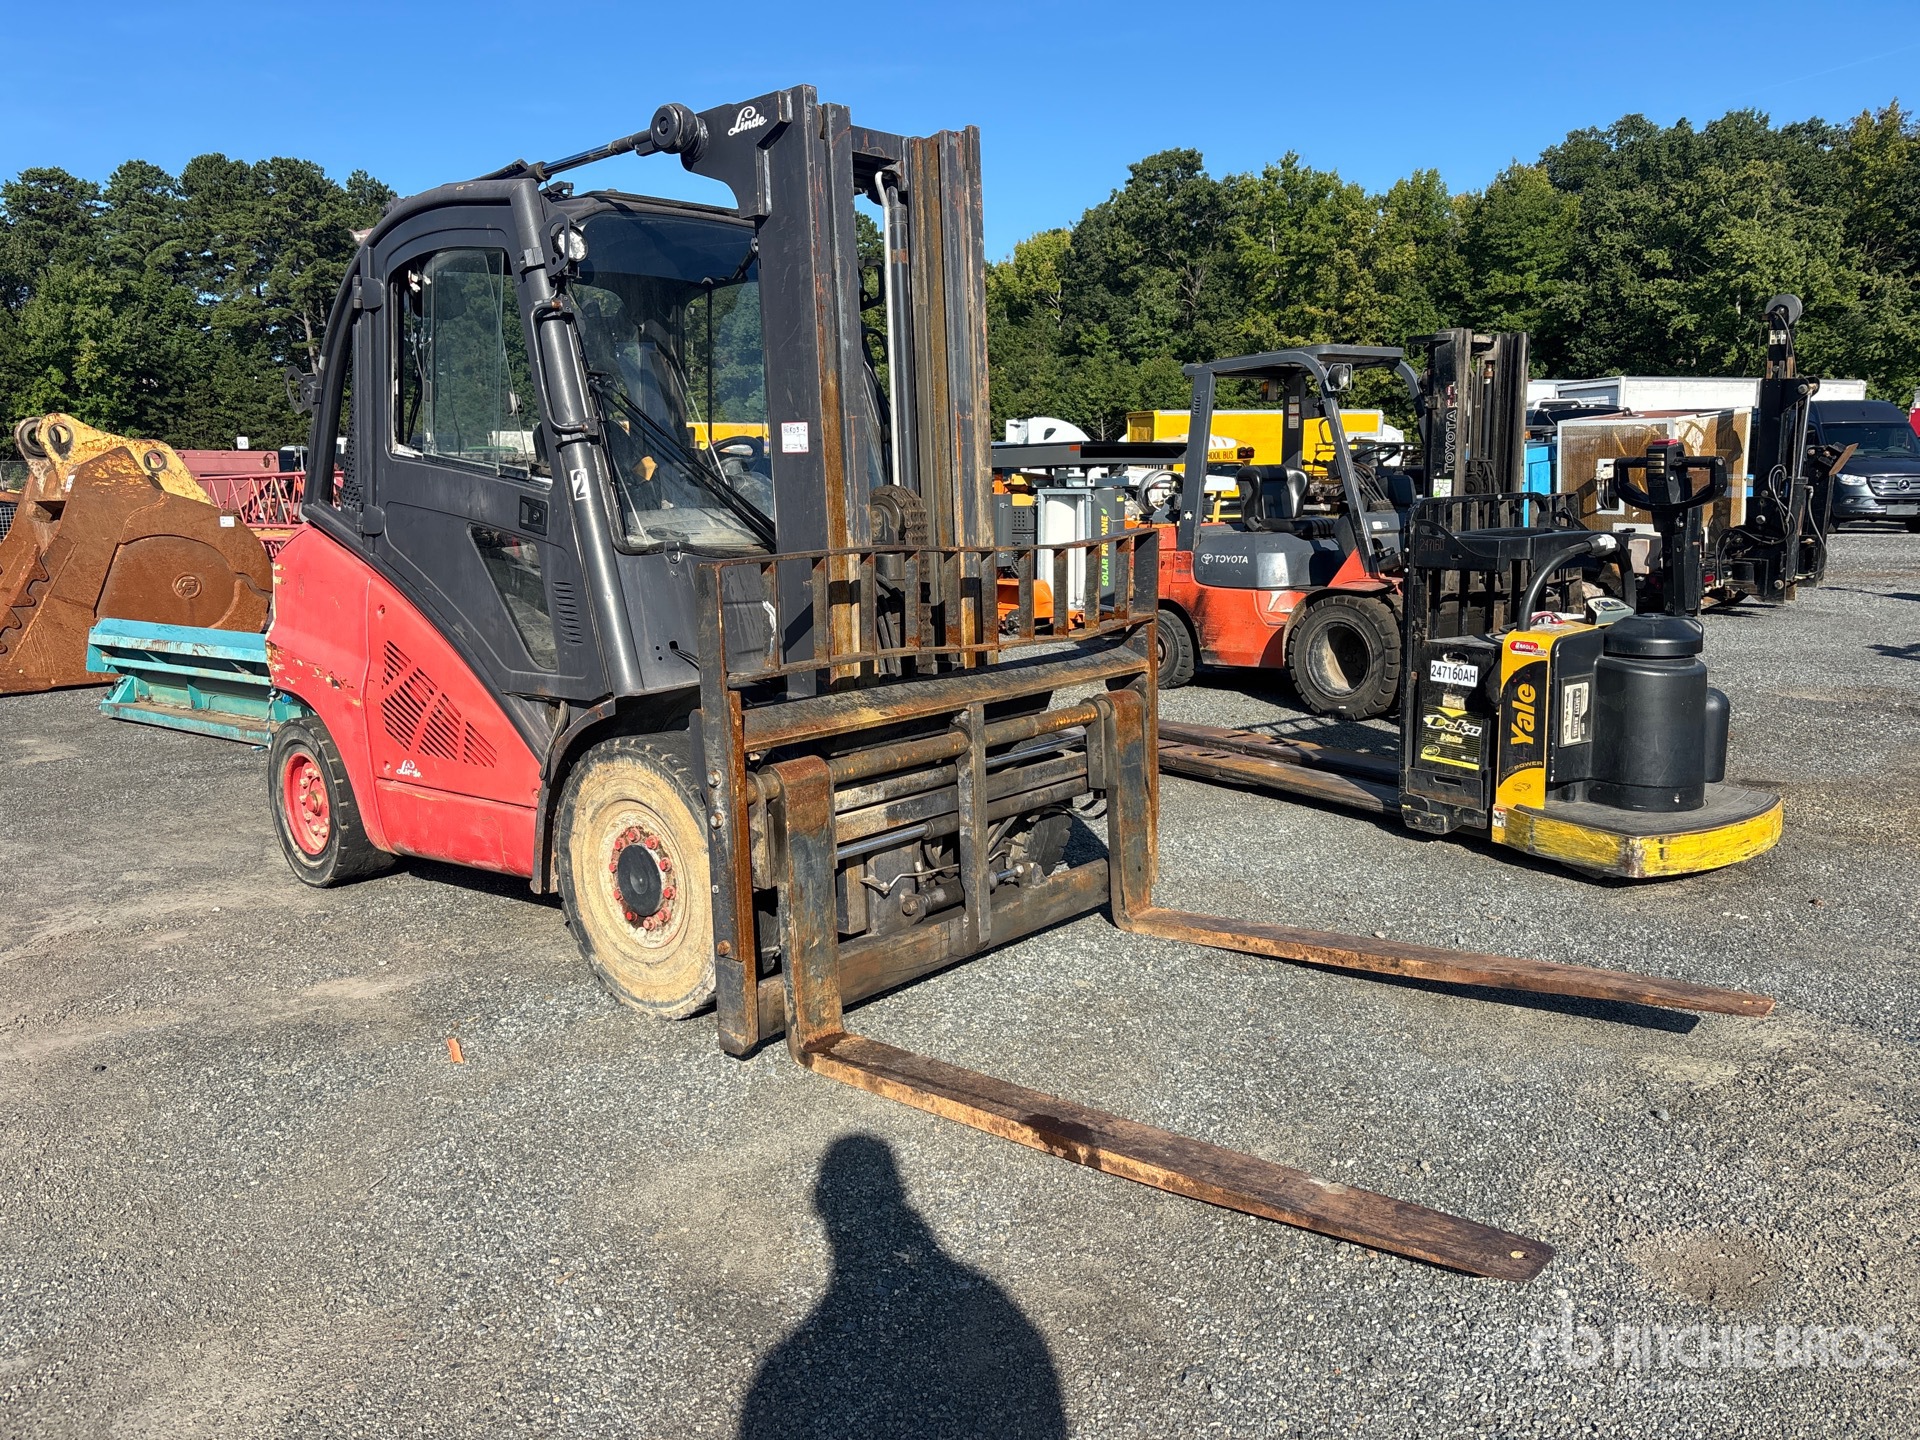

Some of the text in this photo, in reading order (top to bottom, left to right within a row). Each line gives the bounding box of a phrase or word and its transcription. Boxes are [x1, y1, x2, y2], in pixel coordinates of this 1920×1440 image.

[728, 105, 767, 136] Linde
[1444, 409, 1457, 473] TOYOTA
[1207, 451, 1234, 460] HOOL BUS
[573, 470, 587, 499] 2
[1101, 515, 1109, 587] SOLAR PRANE
[1215, 555, 1249, 564] TOYOTA
[1431, 664, 1477, 683] 247160AH
[1423, 714, 1482, 737] Deka
[1510, 683, 1536, 745] Yale
[1514, 760, 1543, 770] POWER
